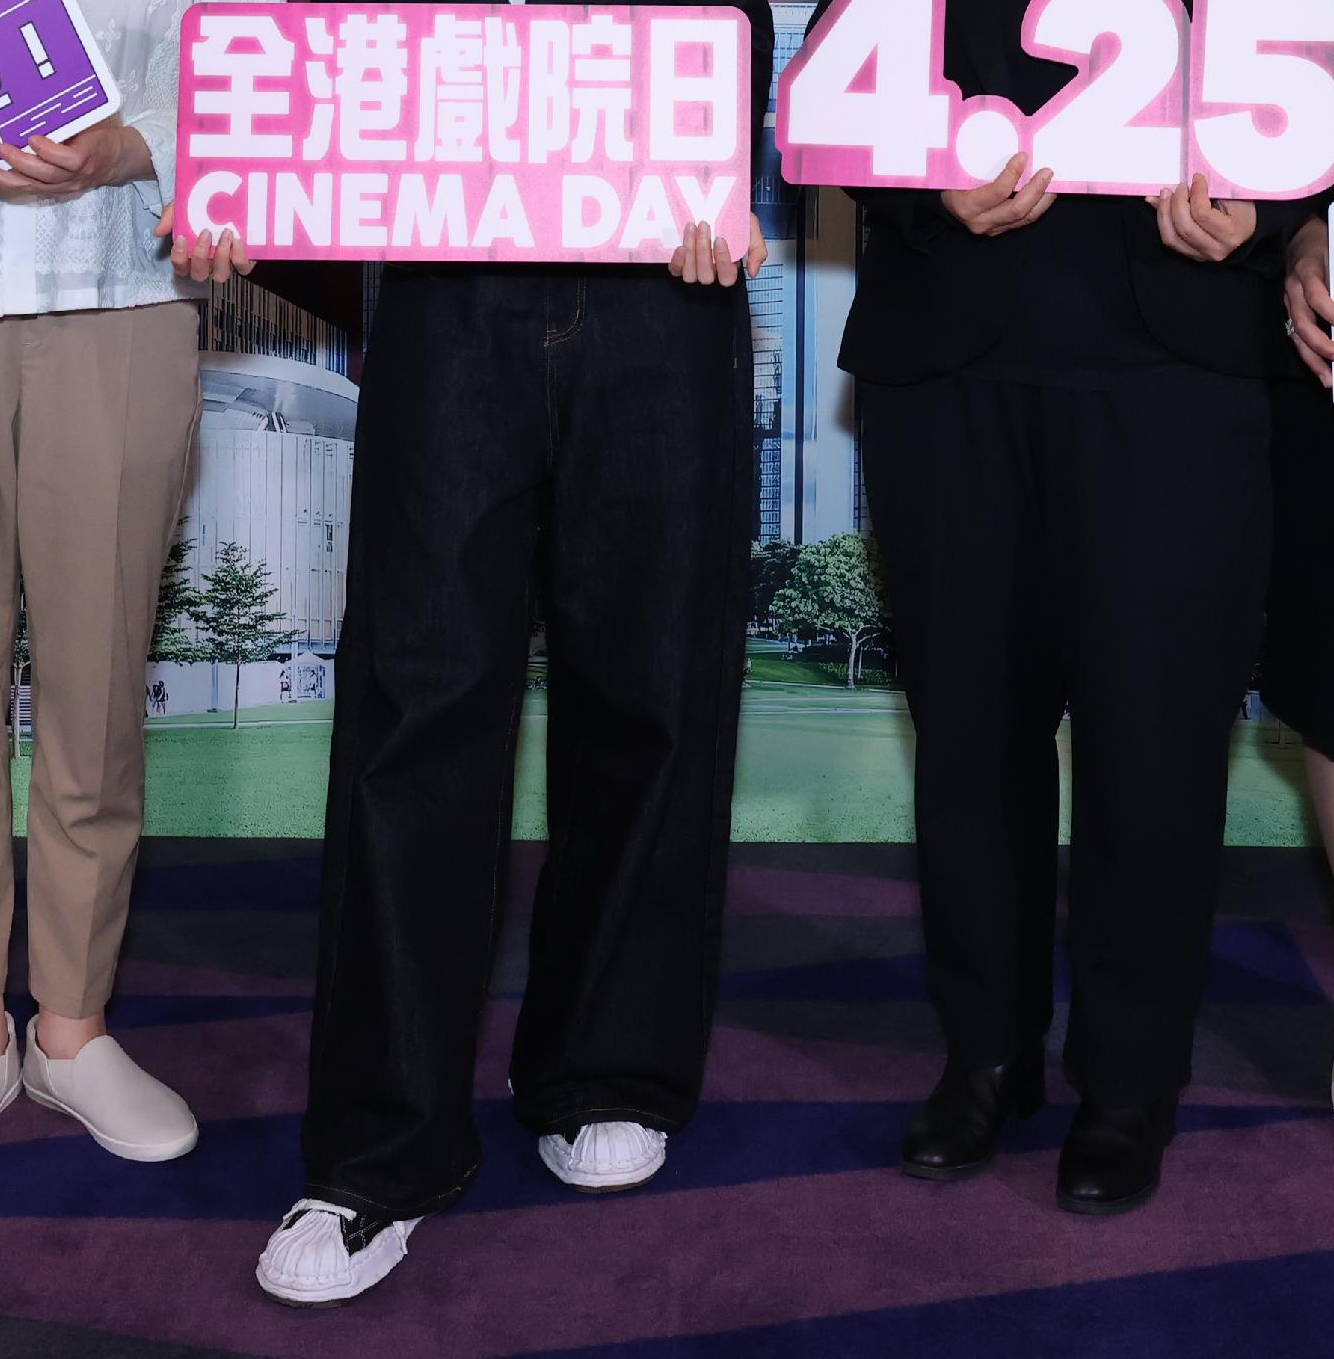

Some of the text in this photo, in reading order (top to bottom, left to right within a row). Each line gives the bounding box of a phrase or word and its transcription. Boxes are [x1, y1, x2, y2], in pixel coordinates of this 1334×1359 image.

[189, 14, 739, 164] 全港戲院日
[187, 171, 736, 250] CINEMA DAY
